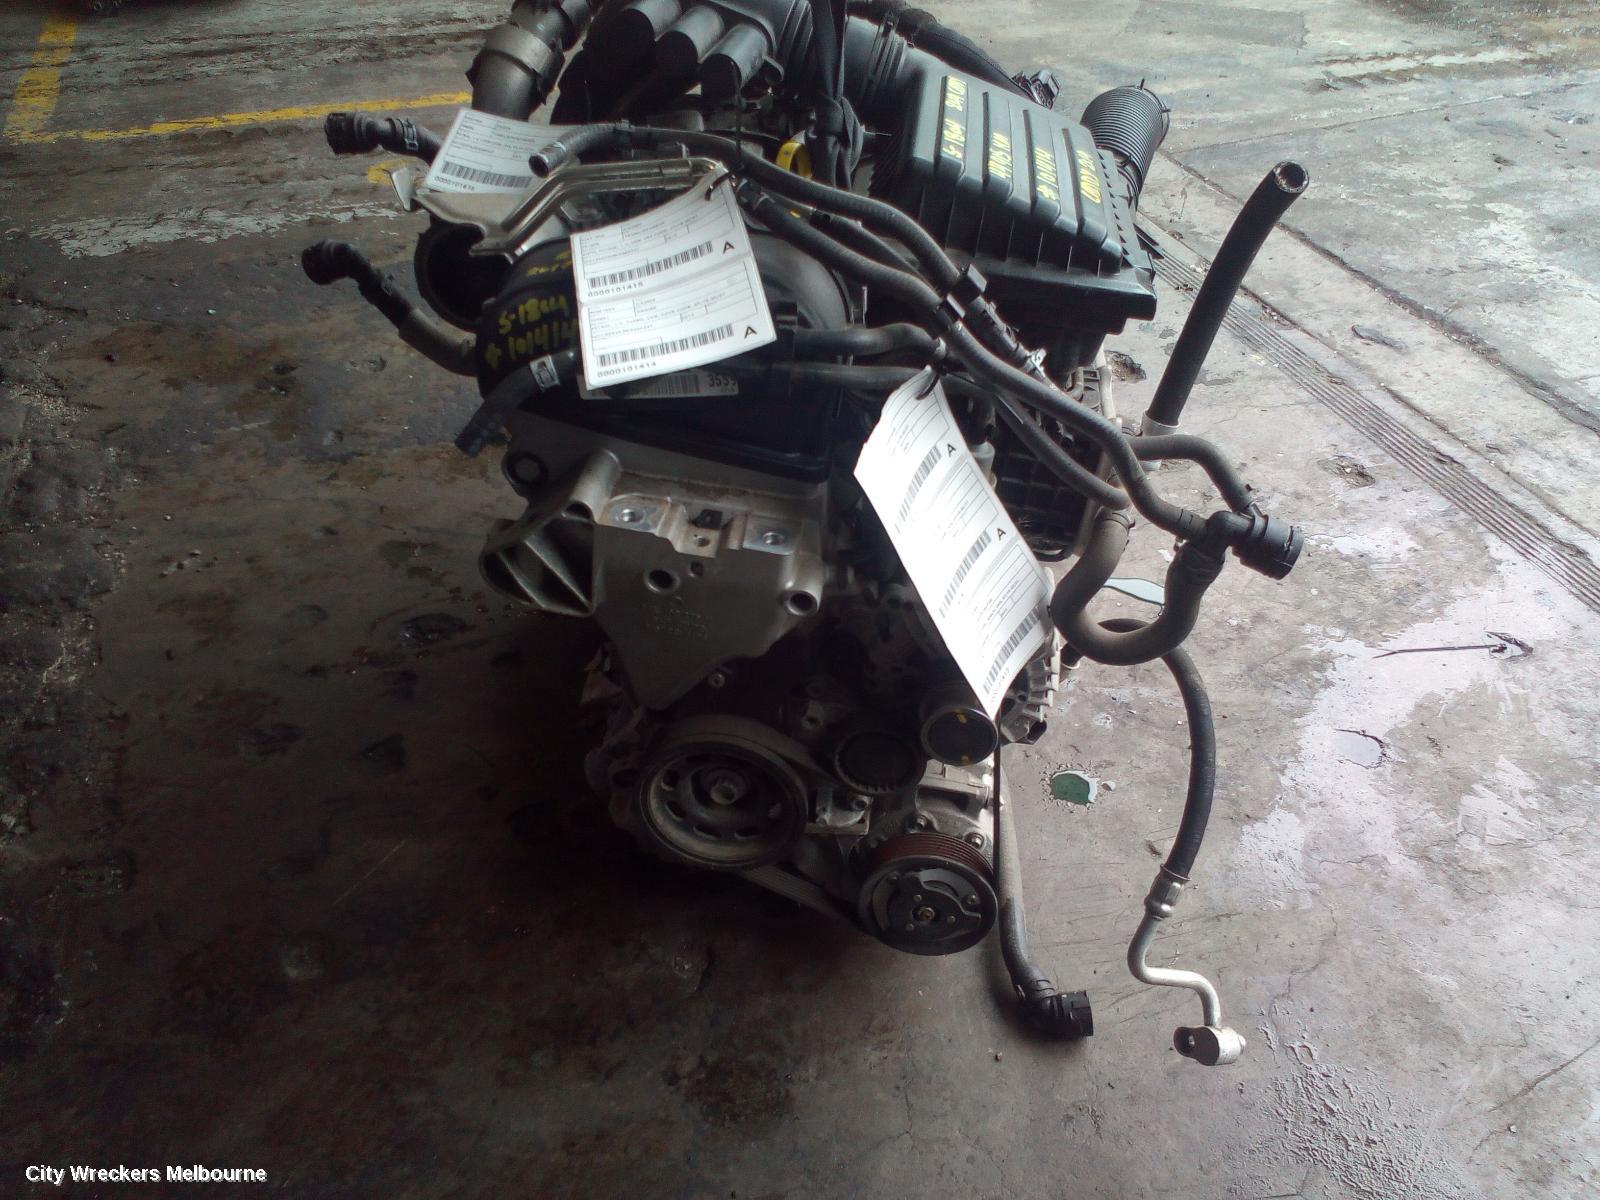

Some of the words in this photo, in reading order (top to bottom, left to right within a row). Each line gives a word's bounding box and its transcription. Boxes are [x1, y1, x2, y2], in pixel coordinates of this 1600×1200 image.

[722, 241, 735, 254] A
[744, 326, 757, 339] A
[947, 443, 956, 457] A
[997, 527, 1006, 541] A
